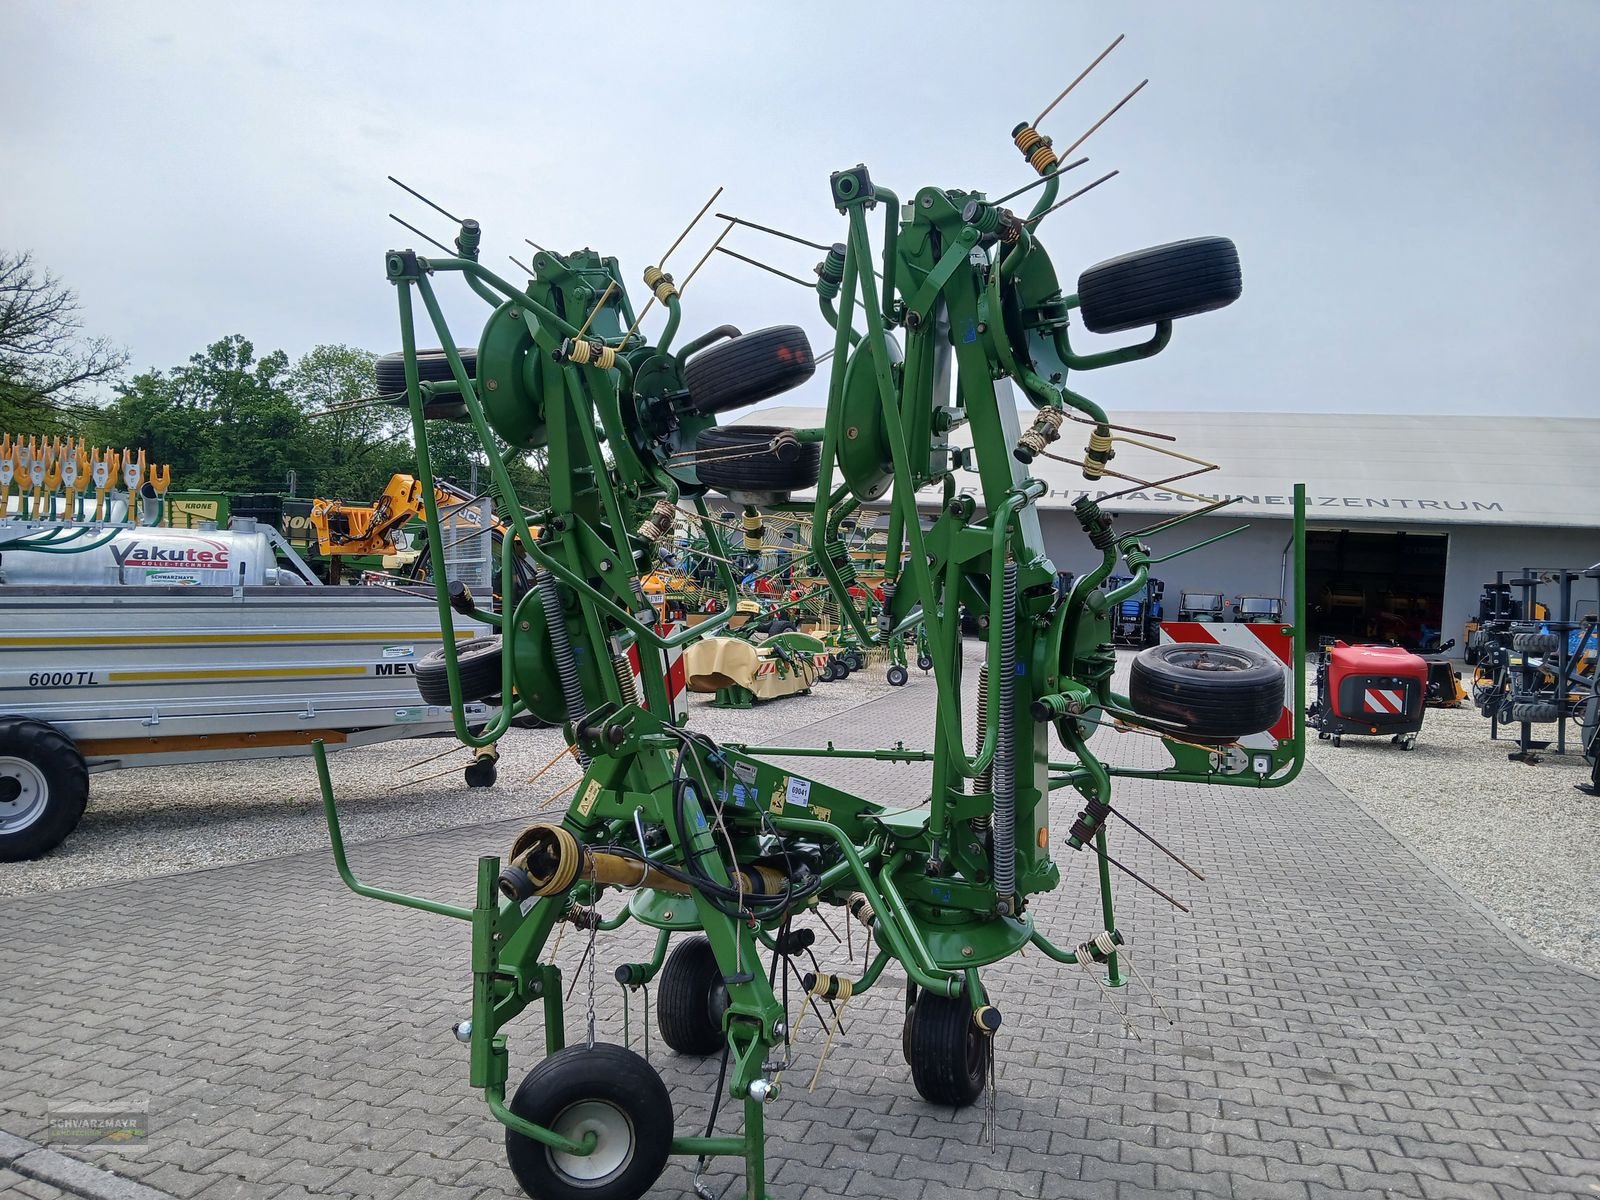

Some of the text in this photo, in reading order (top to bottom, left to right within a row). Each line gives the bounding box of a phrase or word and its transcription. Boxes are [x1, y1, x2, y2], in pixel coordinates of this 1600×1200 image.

[109, 541, 229, 566] Vakutec
[29, 671, 98, 686] 6000 TL
[791, 786, 808, 797] 69041
